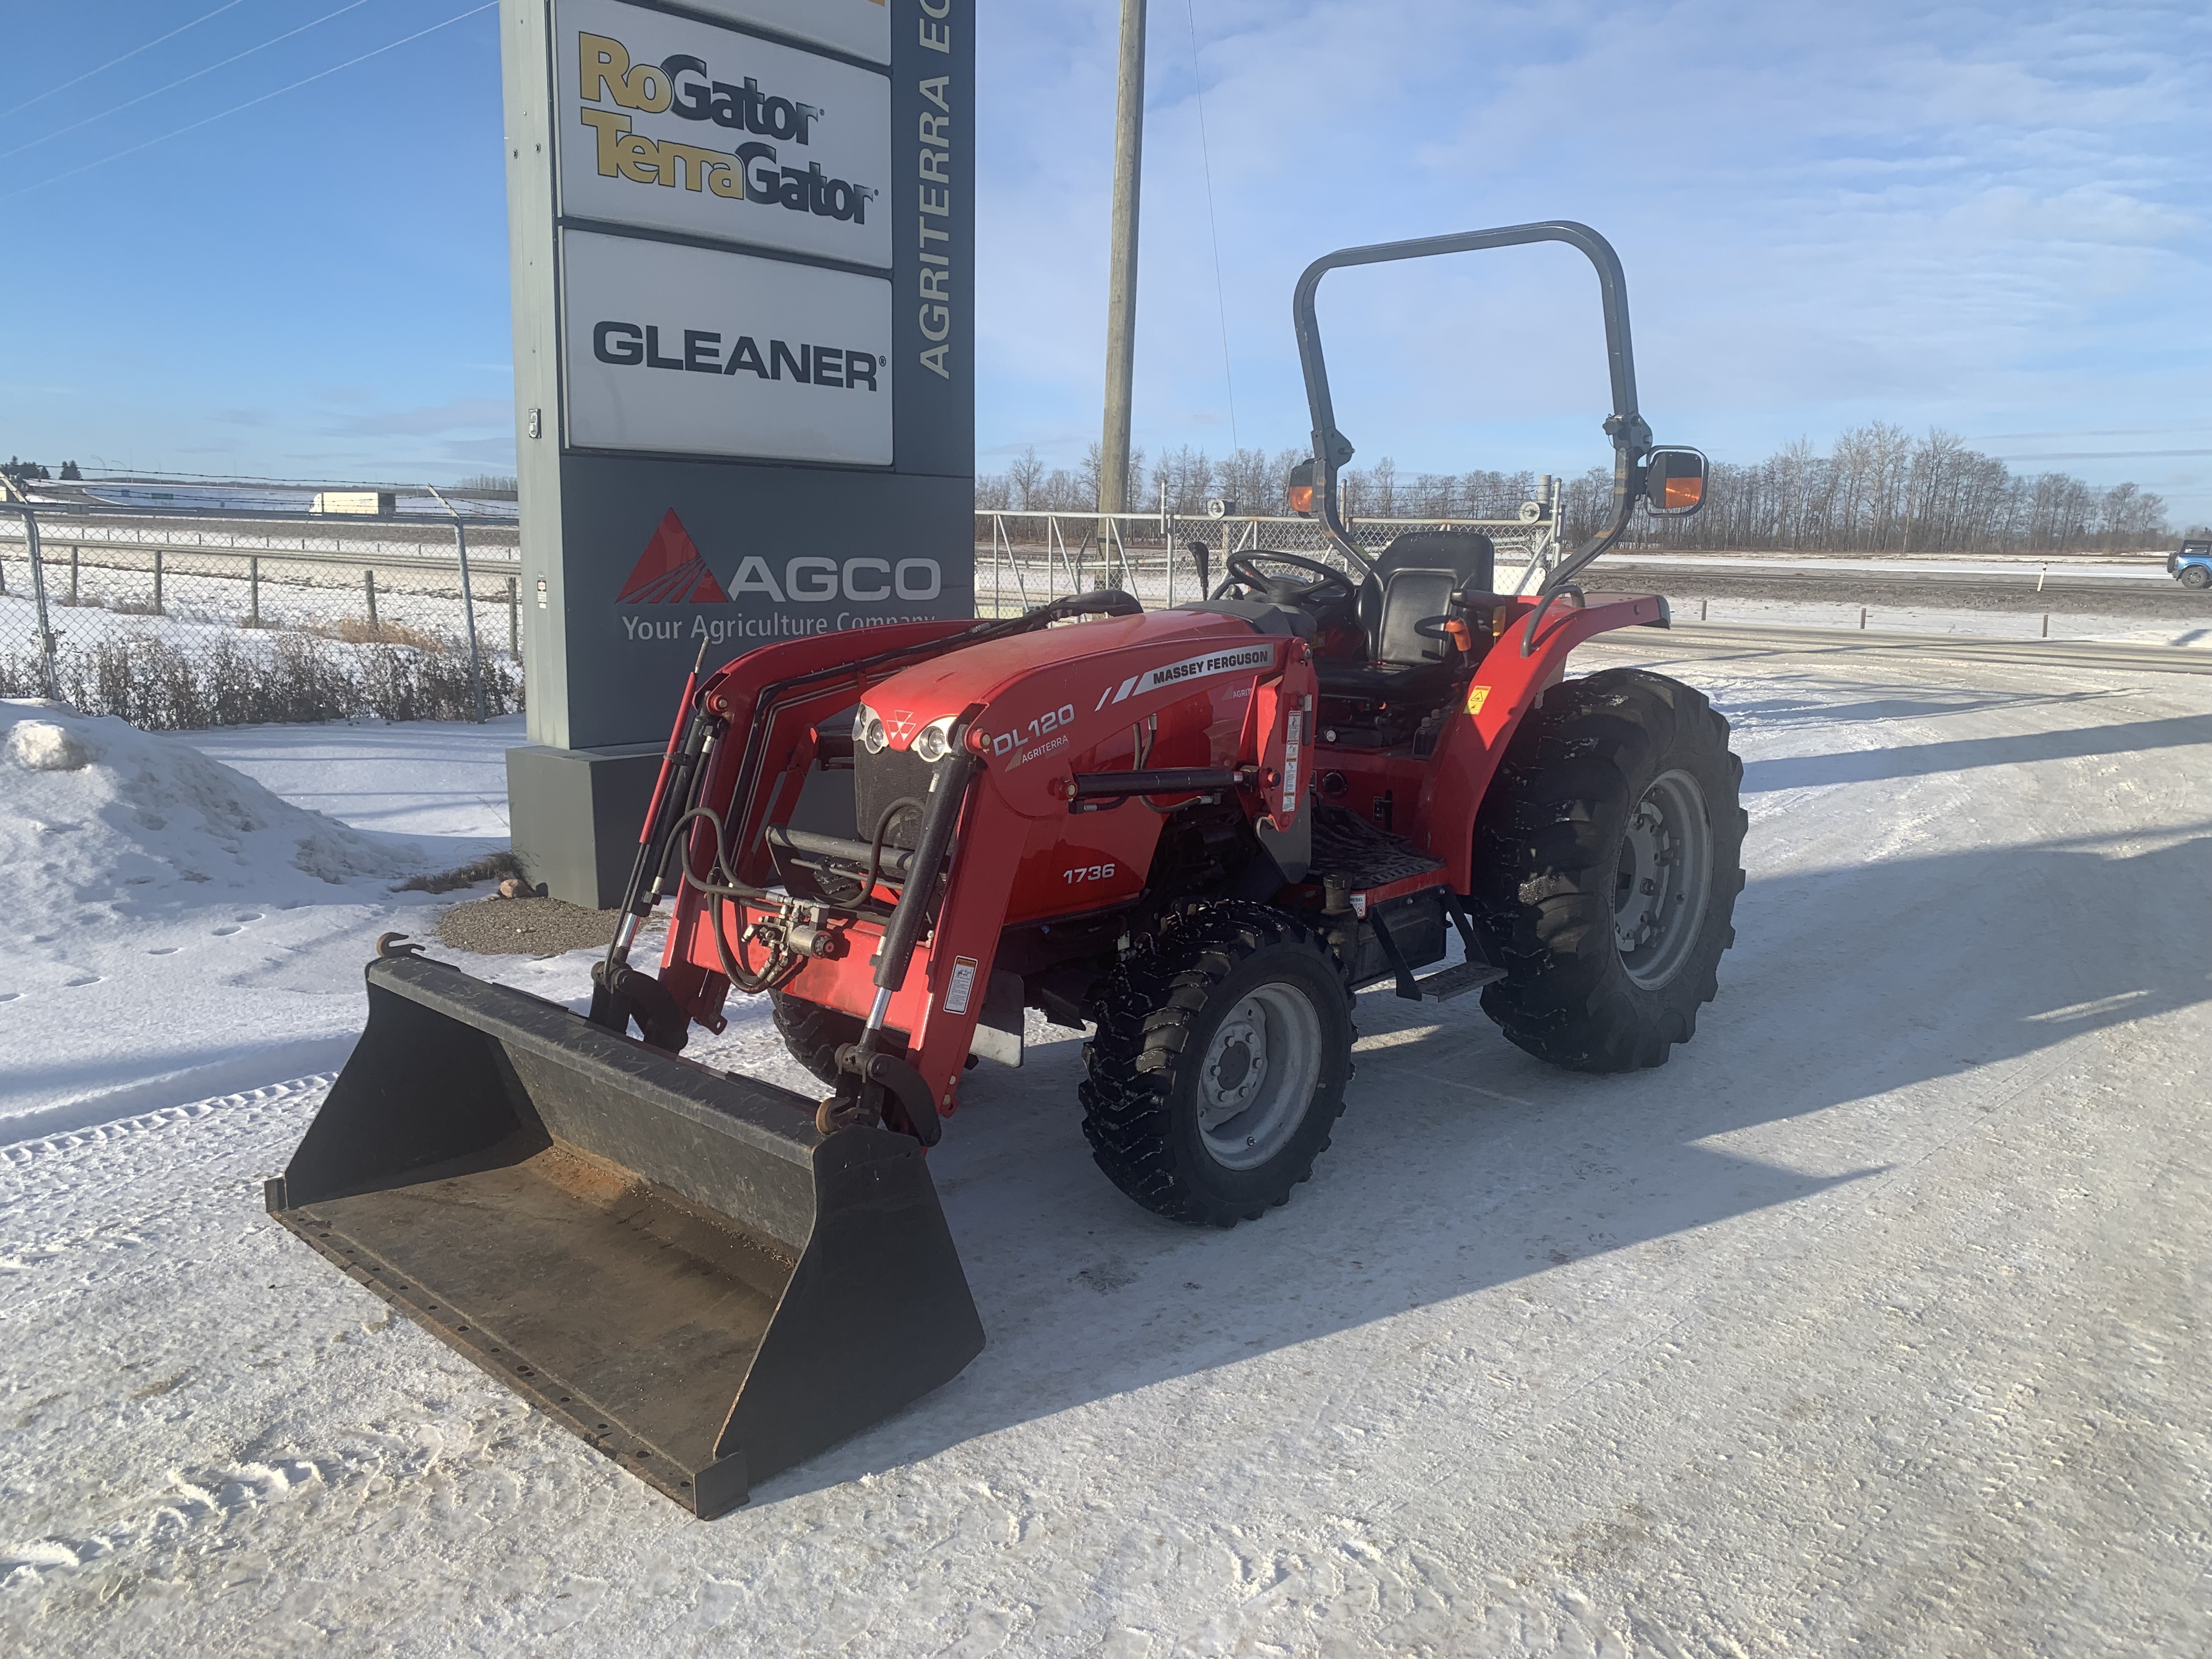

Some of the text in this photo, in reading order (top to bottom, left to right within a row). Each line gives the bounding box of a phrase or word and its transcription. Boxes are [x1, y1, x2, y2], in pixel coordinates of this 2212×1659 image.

[919, 75, 950, 380] AGRITERRA
[728, 556, 941, 602] AGCO
[622, 616, 682, 640] Your
[690, 612, 828, 645] Agriculture
[1153, 651, 1268, 685] MASSEY FERGUSON
[1022, 735, 1068, 764] AGRITERRA
[1063, 864, 1115, 884] 1736
